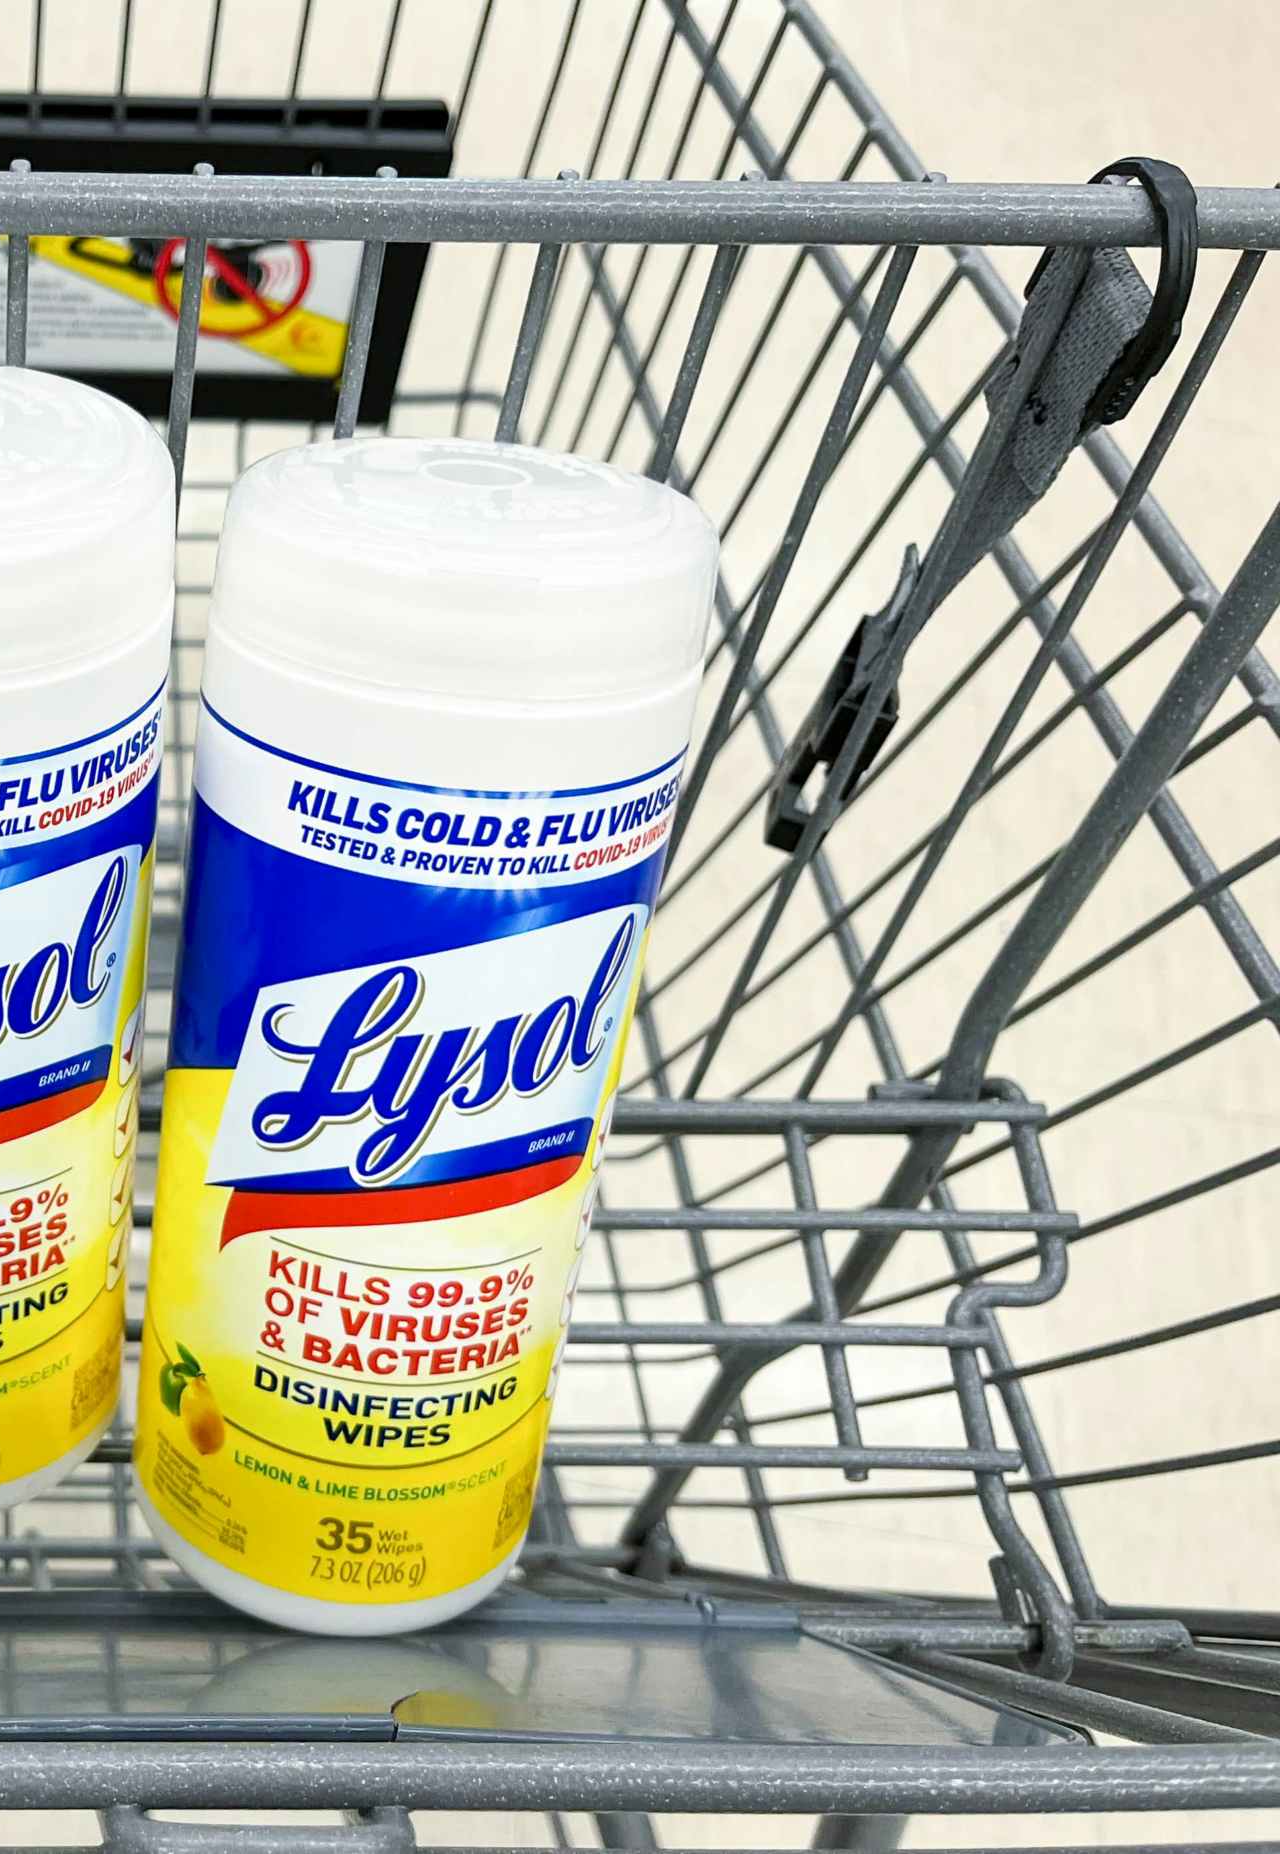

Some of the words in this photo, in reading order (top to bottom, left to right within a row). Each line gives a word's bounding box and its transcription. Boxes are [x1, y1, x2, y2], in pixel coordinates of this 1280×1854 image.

[38, 786, 115, 830] COVID-19
[287, 780, 390, 836] KILLS
[395, 808, 502, 847] COLD
[505, 816, 531, 848] &
[536, 807, 605, 847] FLU
[300, 825, 378, 861] TESTED
[380, 847, 396, 866] &
[400, 849, 493, 875] PROVEN
[498, 857, 525, 876] TO
[528, 853, 571, 875] KILL
[573, 835, 642, 871] COVID-19
[251, 912, 636, 1187] Lysol
[38, 1066, 79, 1087] BRAND
[527, 1133, 565, 1153] BRAND
[269, 1249, 391, 1306] KILLS
[407, 1263, 535, 1310] 99.9%
[265, 1286, 320, 1325] OF
[340, 1297, 529, 1344] VIRUSES
[260, 1320, 286, 1353] &
[253, 1364, 518, 1420] DISINFECTING
[322, 1417, 451, 1450] WIPES
[233, 1449, 293, 1486] LEMON
[297, 1476, 310, 1490] &
[314, 1480, 358, 1500] LIME
[315, 1516, 375, 1555] 35
[376, 1541, 424, 1556] Wipes
[378, 1529, 409, 1542] Wet
[310, 1554, 335, 1580] 7.3
[339, 1560, 363, 1583] OZ
[366, 1559, 405, 1591] (206
[408, 1555, 427, 1588] g)
